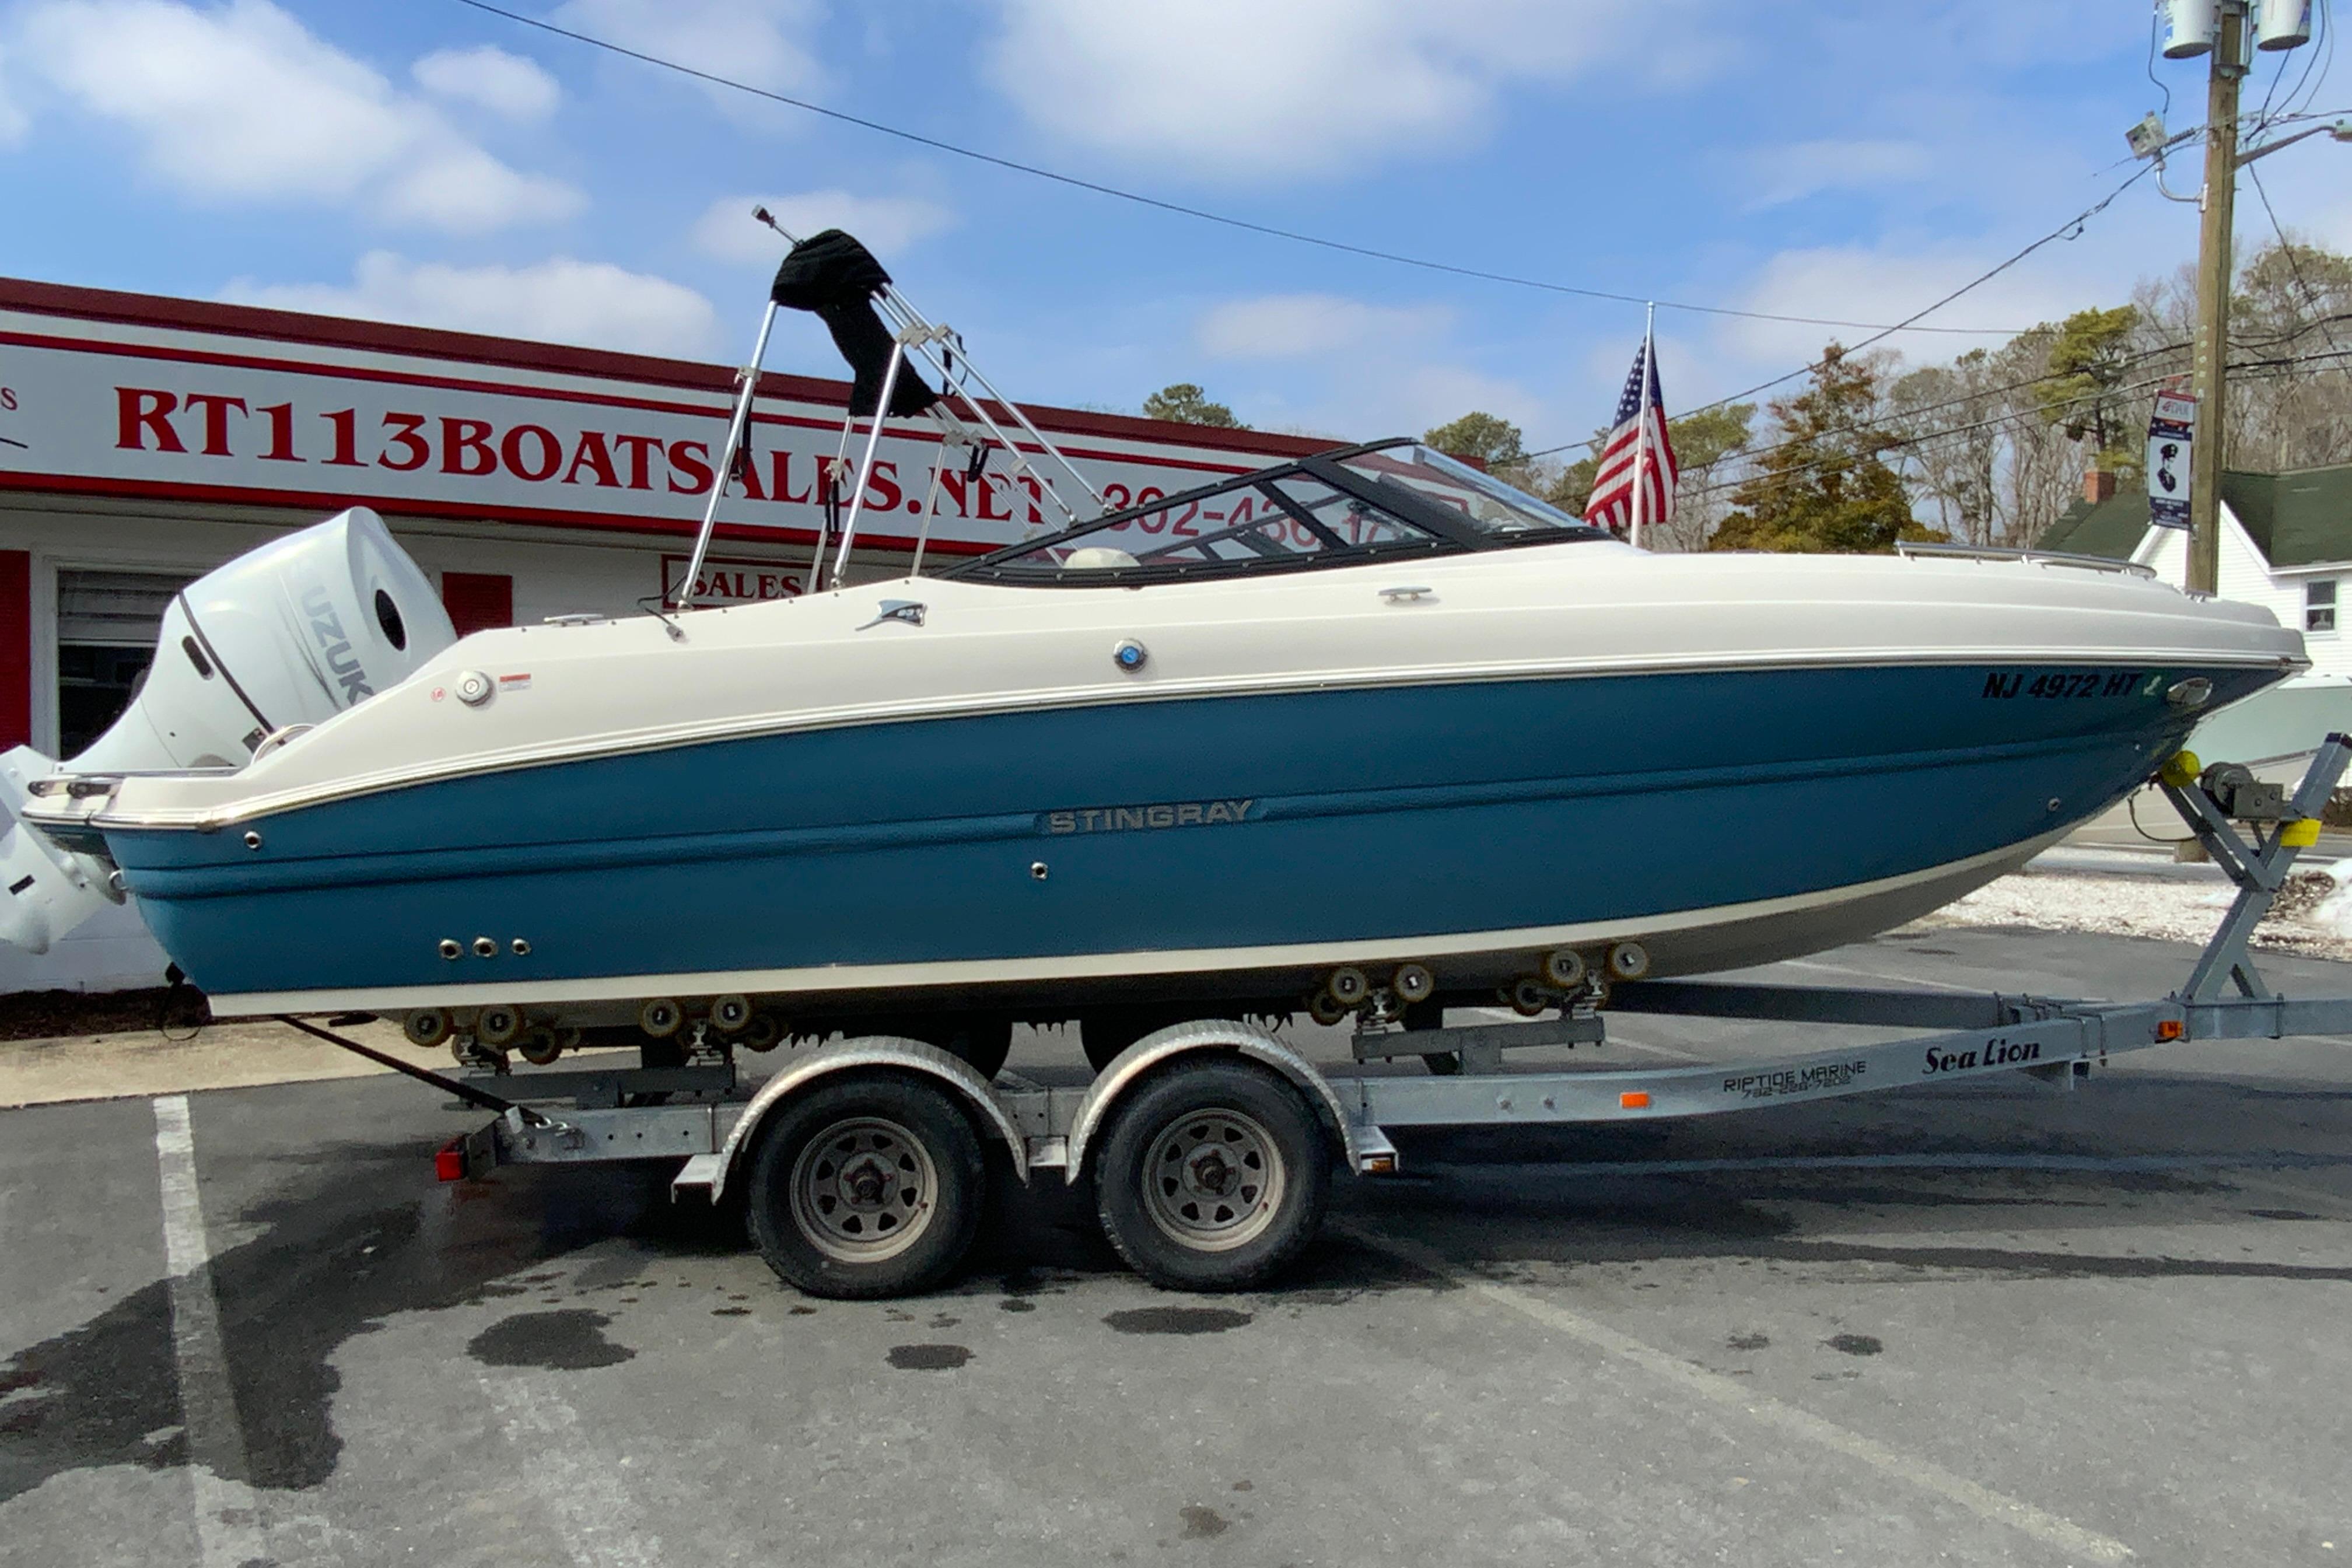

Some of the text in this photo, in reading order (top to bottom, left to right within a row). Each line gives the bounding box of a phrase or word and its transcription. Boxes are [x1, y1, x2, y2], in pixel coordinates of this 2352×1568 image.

[692, 569, 803, 600] SALES
[301, 585, 375, 706] UZUK
[1982, 673, 2024, 699] NJ
[2027, 674, 2100, 699] 4972
[1049, 800, 1253, 835] STINGRAY
[1922, 1038, 2041, 1074] Sea Lion
[1723, 1060, 1867, 1093] RIPTIDE MARINE
